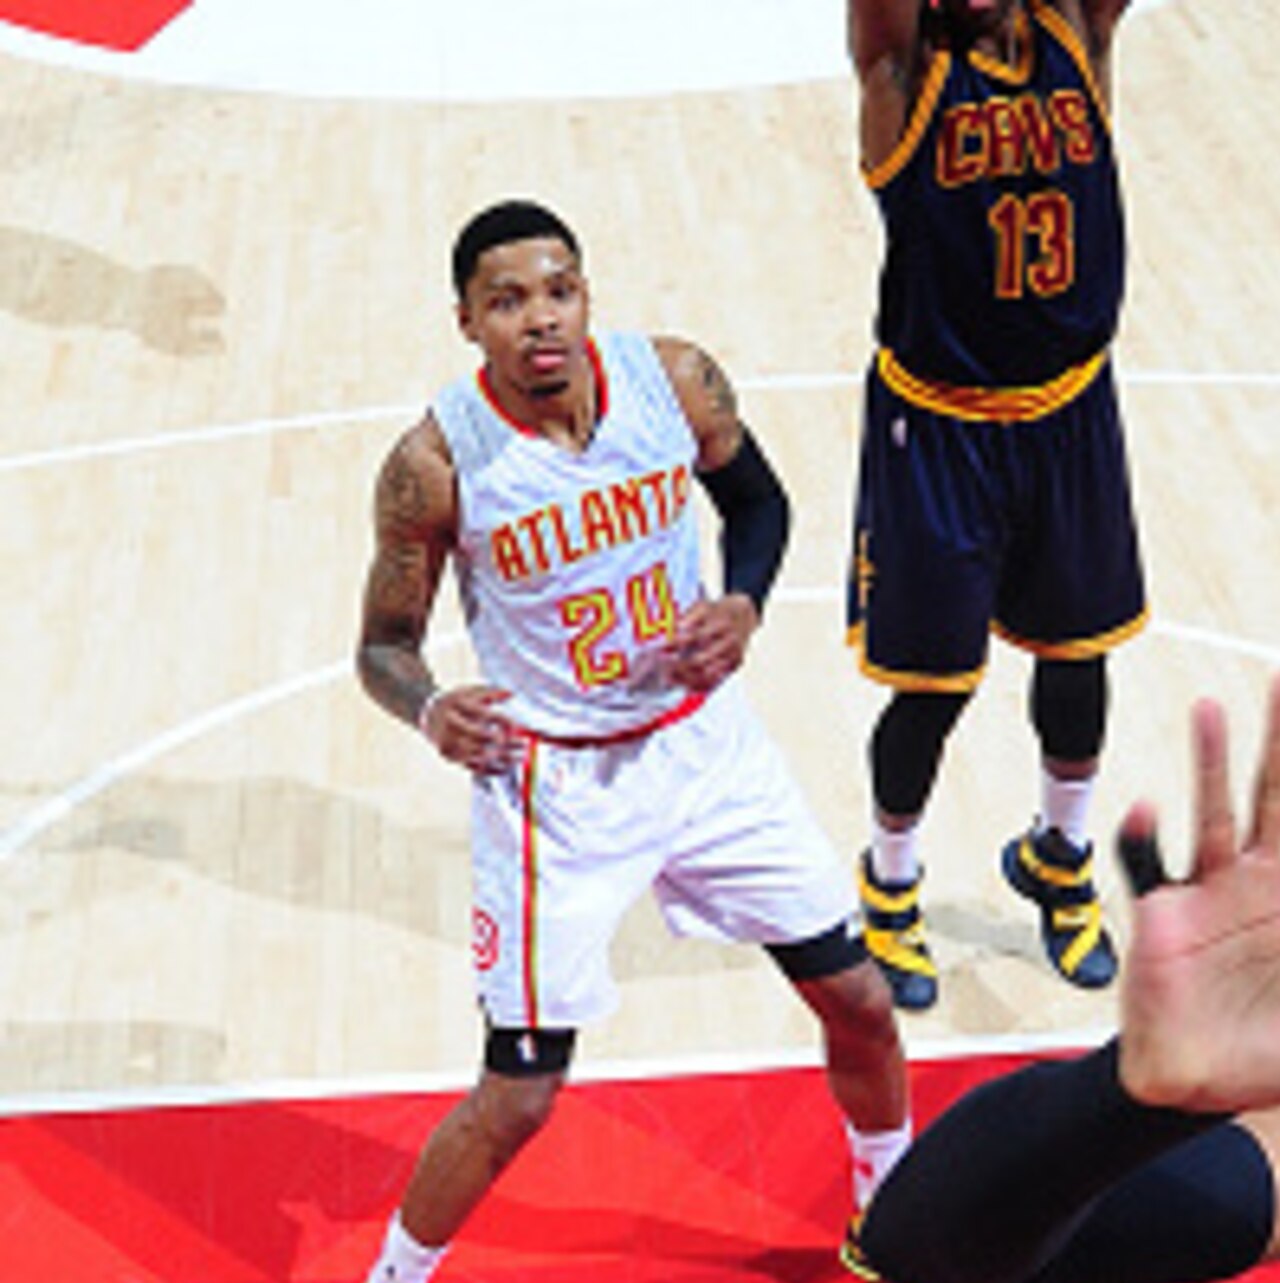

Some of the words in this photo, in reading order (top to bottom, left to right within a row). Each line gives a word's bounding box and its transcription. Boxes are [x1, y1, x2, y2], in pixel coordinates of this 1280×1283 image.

[937, 89, 1096, 189] CAVS
[988, 189, 1074, 299] 13
[557, 560, 679, 692] 24
